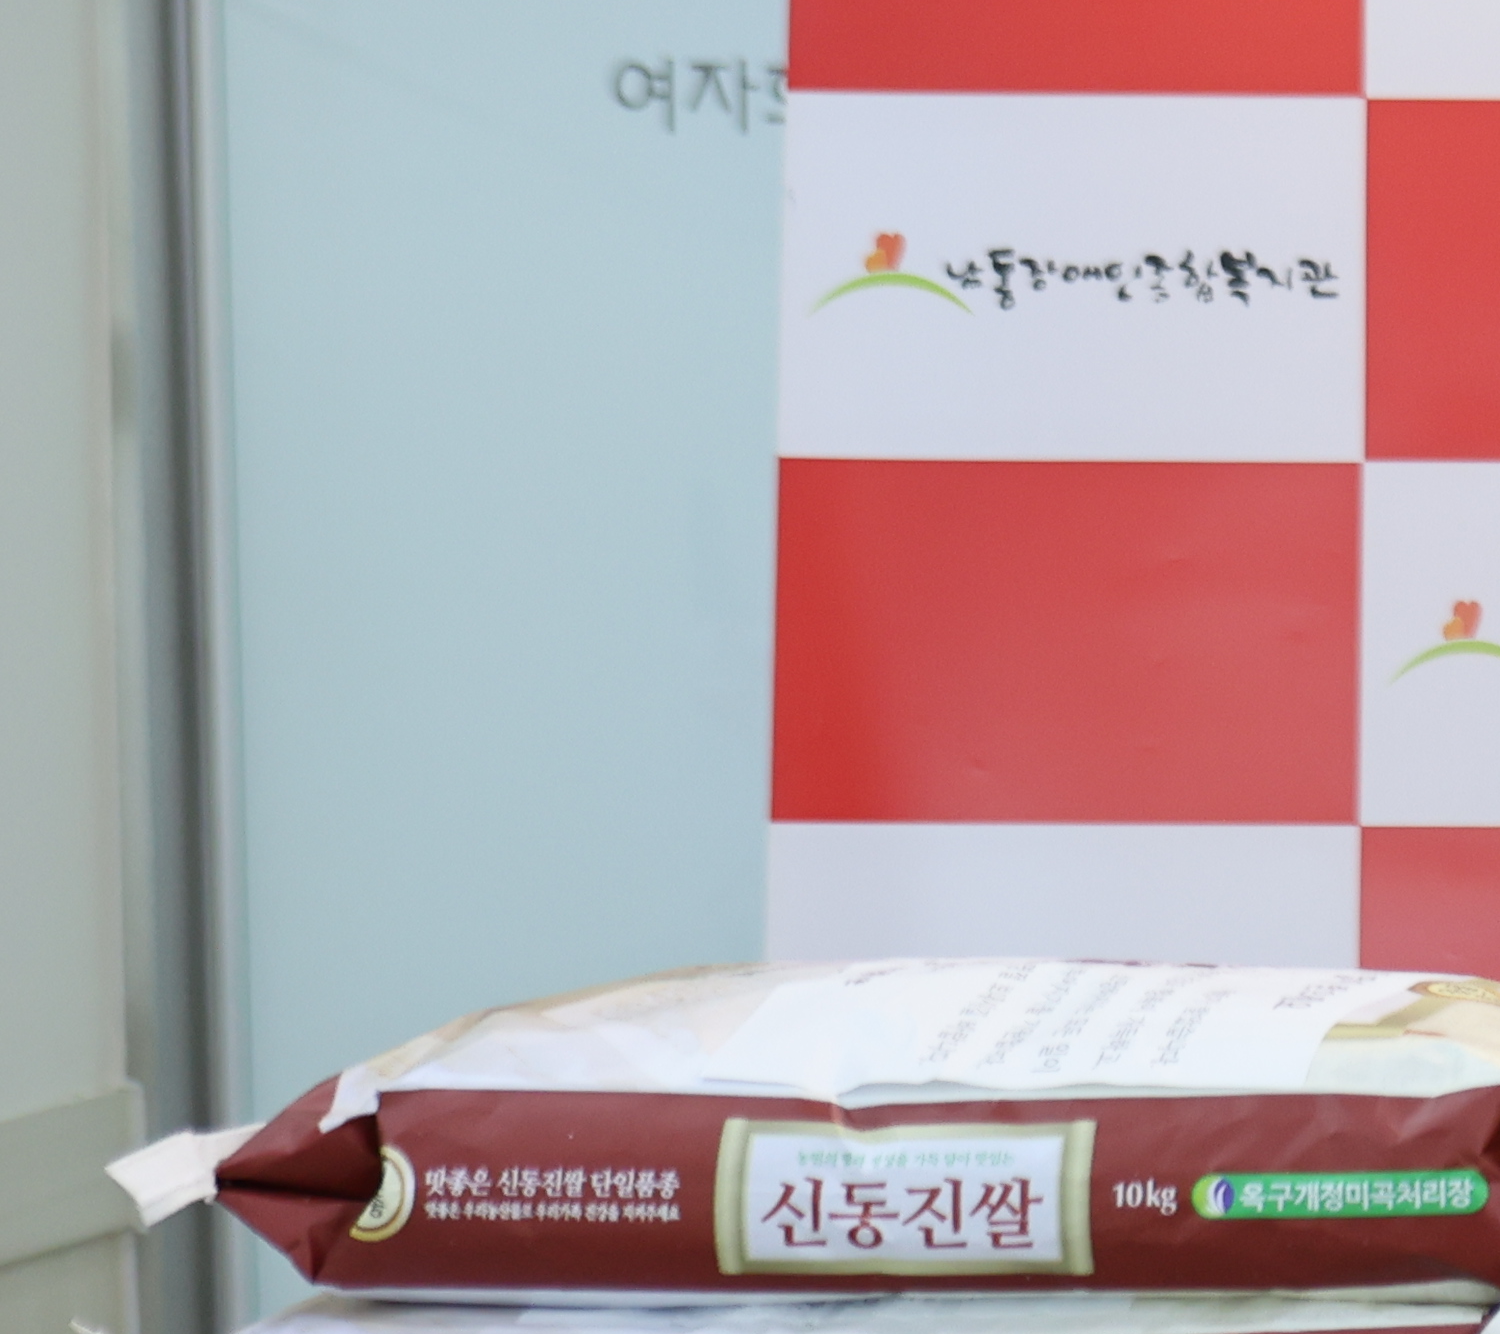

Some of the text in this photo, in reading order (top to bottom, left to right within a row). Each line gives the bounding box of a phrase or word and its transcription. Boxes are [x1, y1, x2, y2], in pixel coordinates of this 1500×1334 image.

[945, 248, 1338, 309] 남동장애인종합복지관
[425, 1167, 679, 1197] 맛좋은 신동진쌀 단일품종
[1114, 1179, 1176, 1214] 10kg
[1239, 1178, 1474, 1211] 옥구개정미곡처리장
[763, 1178, 1042, 1249] 신동진쌀
